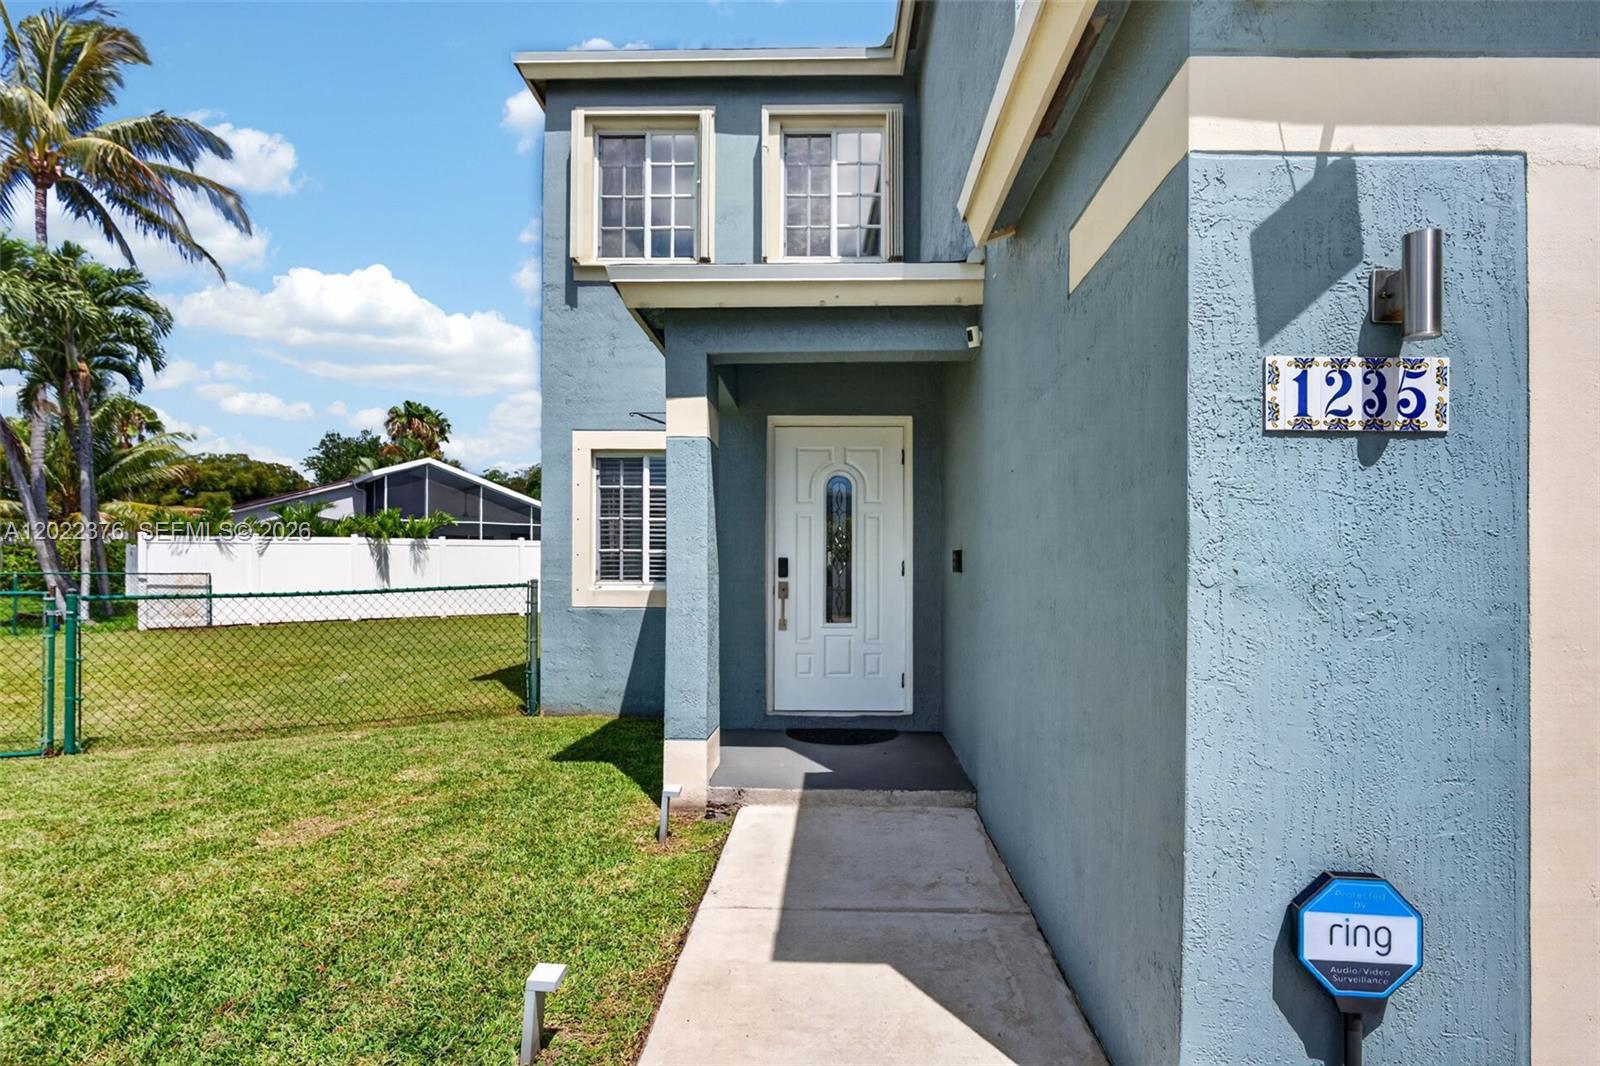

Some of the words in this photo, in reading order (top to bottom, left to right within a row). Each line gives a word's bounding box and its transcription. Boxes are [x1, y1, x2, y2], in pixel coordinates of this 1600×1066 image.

[1292, 369, 1428, 419] 1235
[1329, 917, 1392, 957] ring
[1332, 973, 1389, 985] Surveillance
